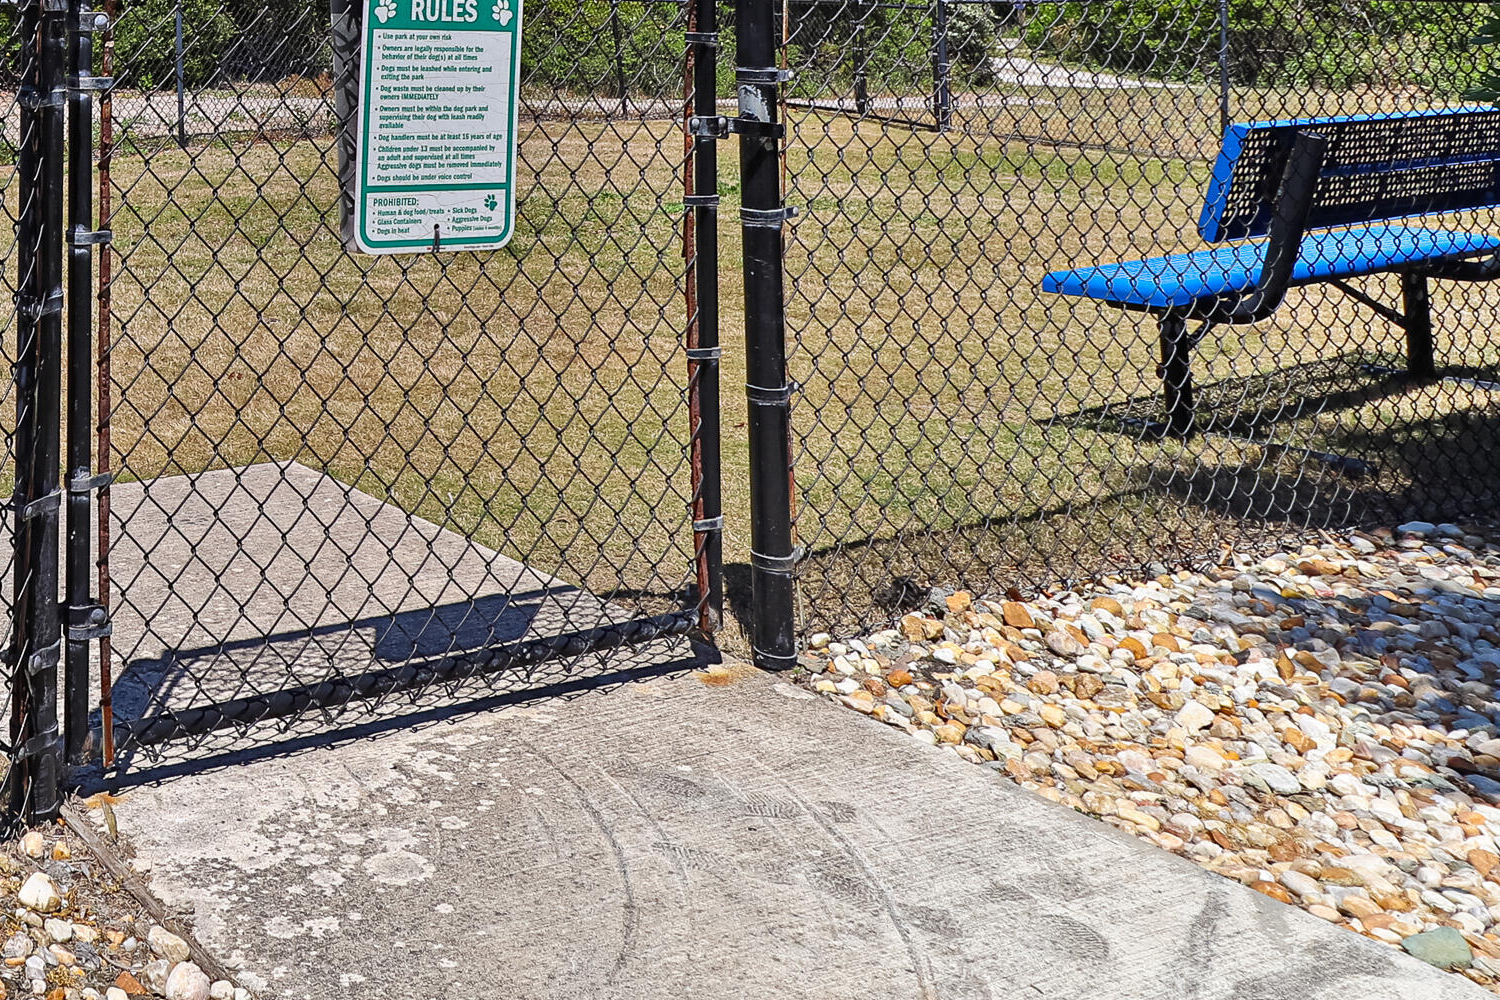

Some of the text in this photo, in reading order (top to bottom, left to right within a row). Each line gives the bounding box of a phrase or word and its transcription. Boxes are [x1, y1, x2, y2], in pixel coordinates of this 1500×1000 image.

[395, 33, 407, 41] park
[415, 46, 432, 54] legally
[434, 46, 464, 54] responsible
[381, 65, 395, 73] Dogs
[459, 66, 481, 74] entering
[381, 73, 399, 81] exiting
[380, 85, 391, 93] Dog
[453, 105, 463, 113] dog
[467, 113, 485, 121] readily
[378, 134, 390, 142] Dog
[452, 145, 487, 153] accompanied
[415, 153, 443, 162] supervised
[373, 198, 419, 207] PROHIBITED:
[403, 209, 413, 217] dog
[452, 216, 479, 224] Aggressive
